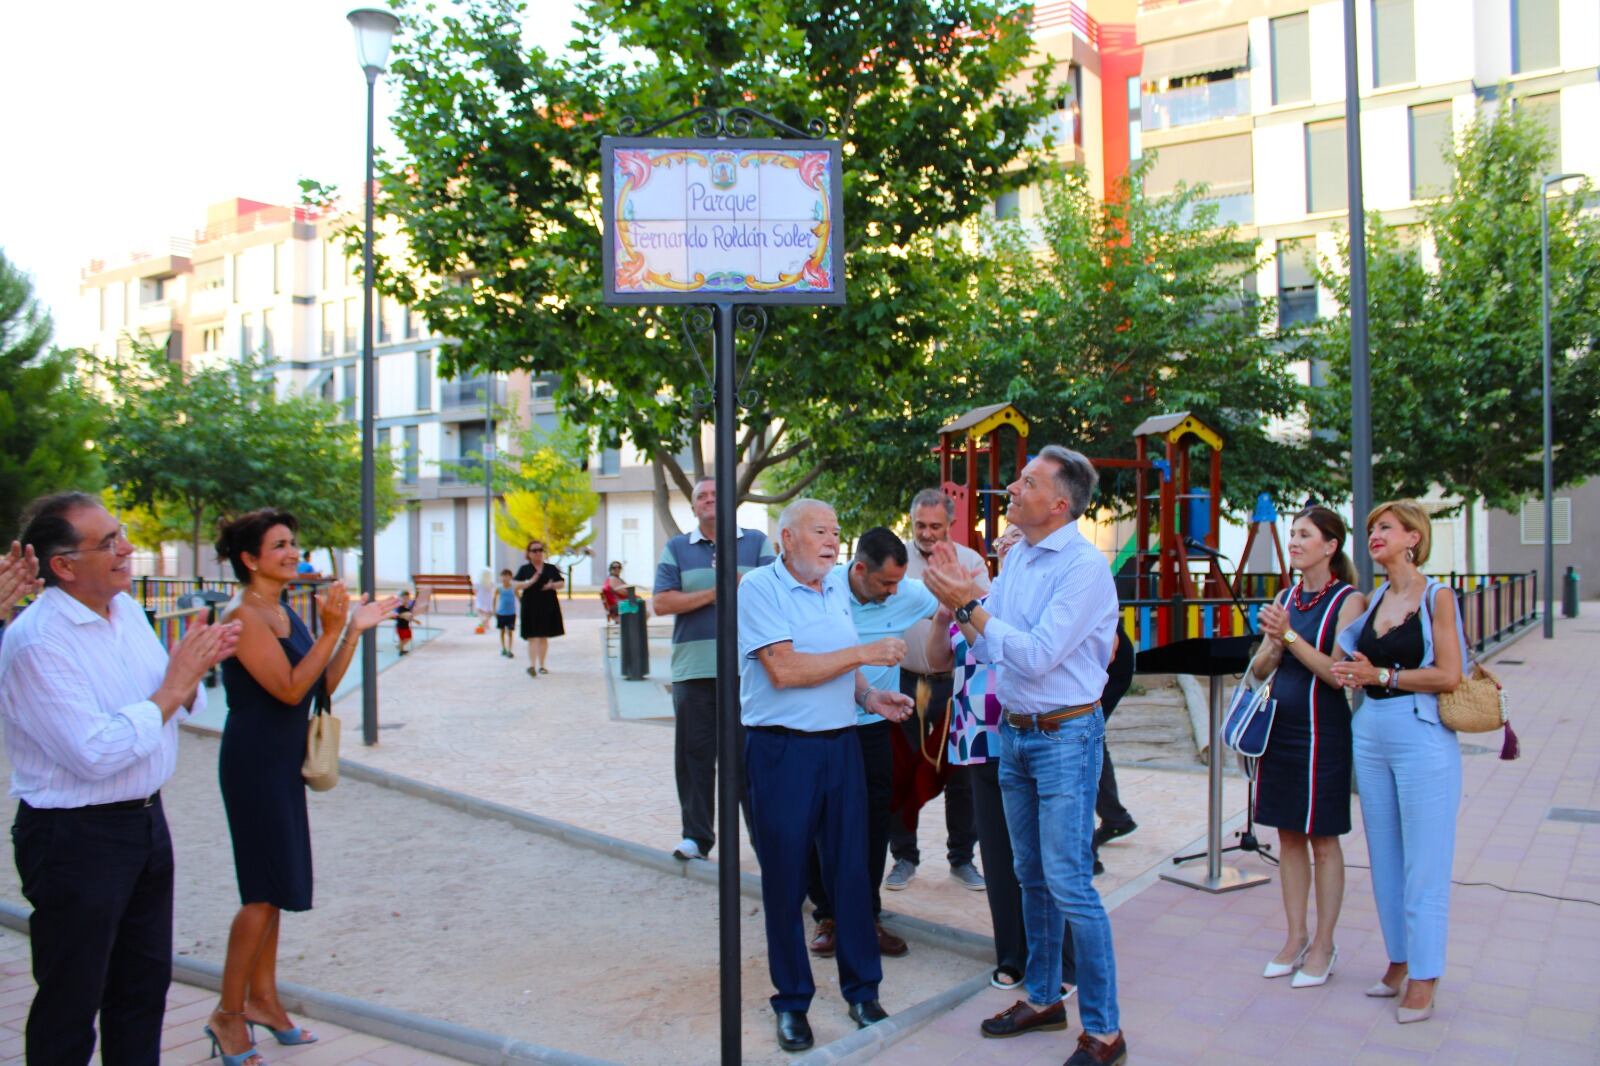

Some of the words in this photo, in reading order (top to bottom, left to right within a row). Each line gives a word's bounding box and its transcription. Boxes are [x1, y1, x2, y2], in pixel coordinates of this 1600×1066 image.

[688, 182, 757, 221] Parque
[629, 223, 708, 249] Fernando
[713, 224, 768, 251] Roldán
[773, 222, 813, 249] Soler
